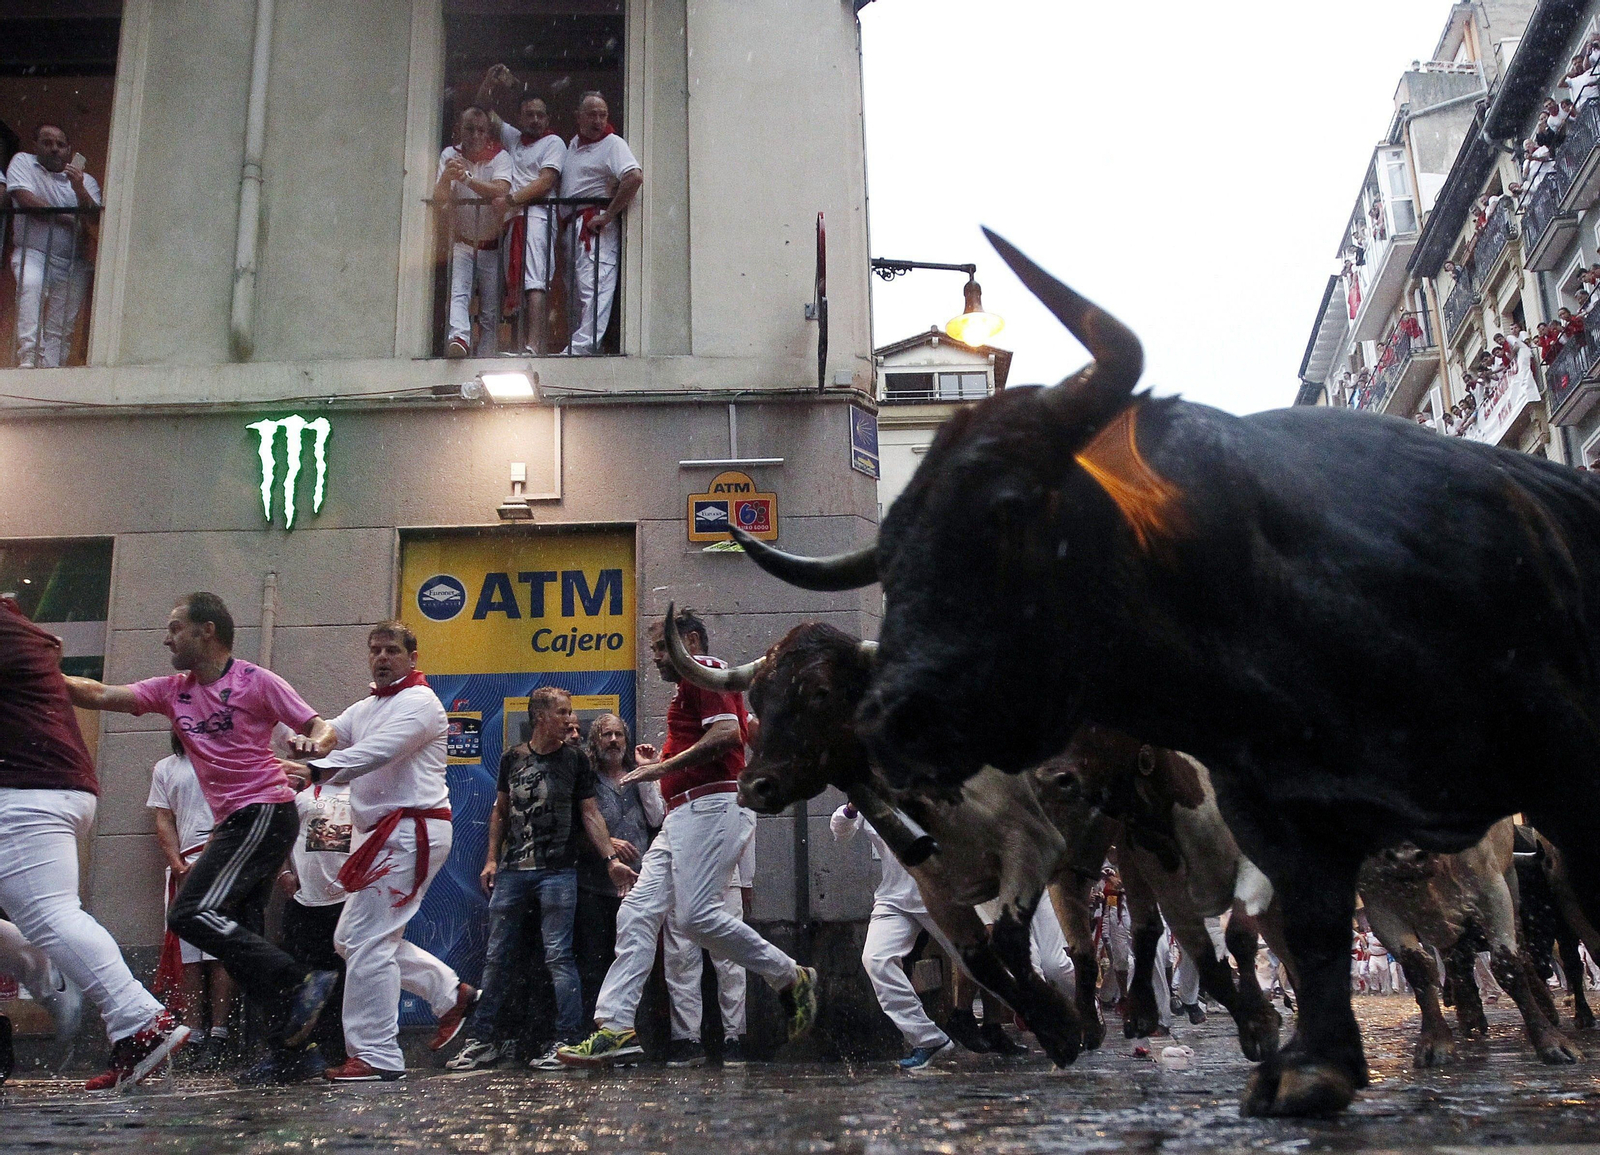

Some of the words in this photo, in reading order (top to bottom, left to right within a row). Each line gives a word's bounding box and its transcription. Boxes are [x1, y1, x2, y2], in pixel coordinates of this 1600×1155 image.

[713, 482, 751, 493] ATM
[429, 589, 455, 597] Euronet
[472, 568, 623, 620] ATM
[531, 627, 624, 658] Cajero
